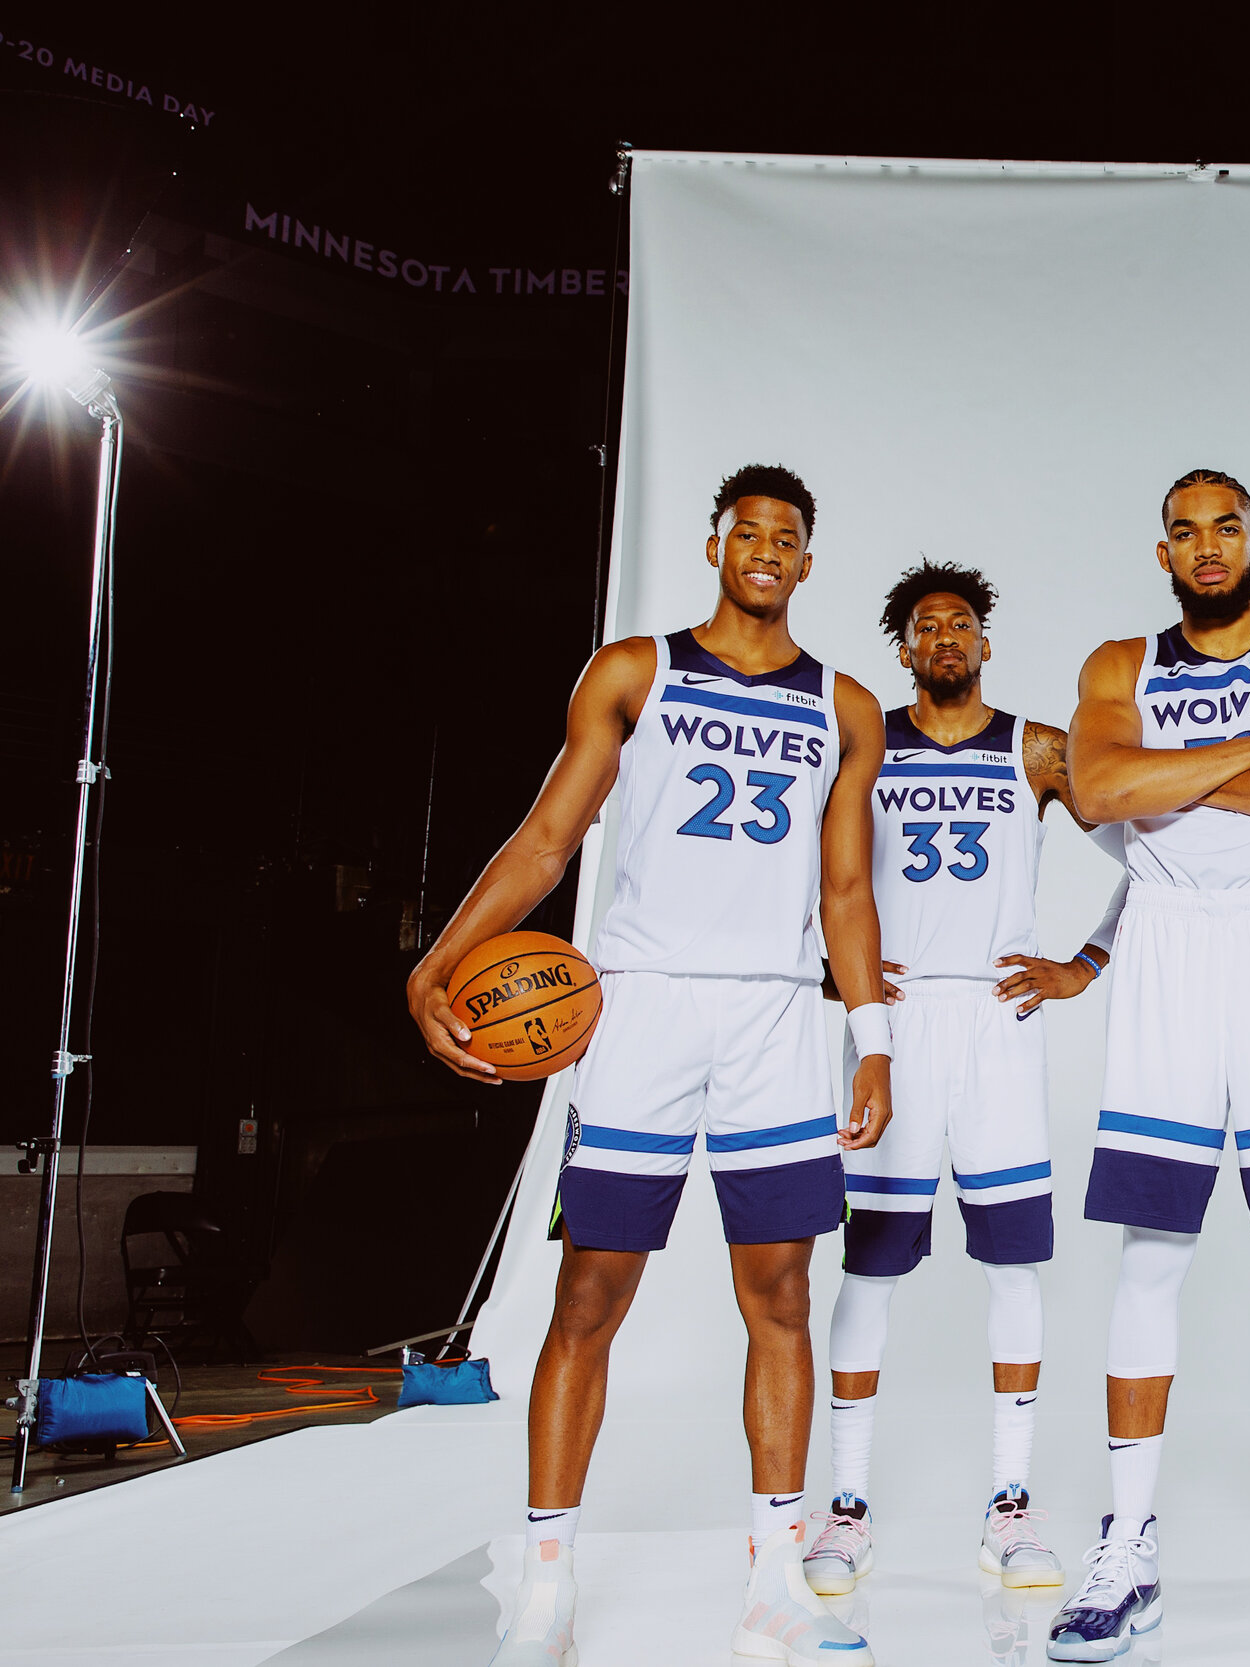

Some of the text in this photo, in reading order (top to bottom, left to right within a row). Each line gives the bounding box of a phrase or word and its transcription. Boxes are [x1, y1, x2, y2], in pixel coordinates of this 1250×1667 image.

[0, 31, 216, 127] -20 MEDIA DAY
[244, 201, 628, 296] MINNESOTA TIMBER
[786, 693, 817, 708] fitbit
[660, 713, 826, 769] WOLVES
[981, 753, 1008, 764] fitbit
[676, 763, 797, 845] 23
[877, 786, 1016, 814] WOLVES
[902, 821, 991, 883] 33
[465, 963, 573, 1024] SPALDING
